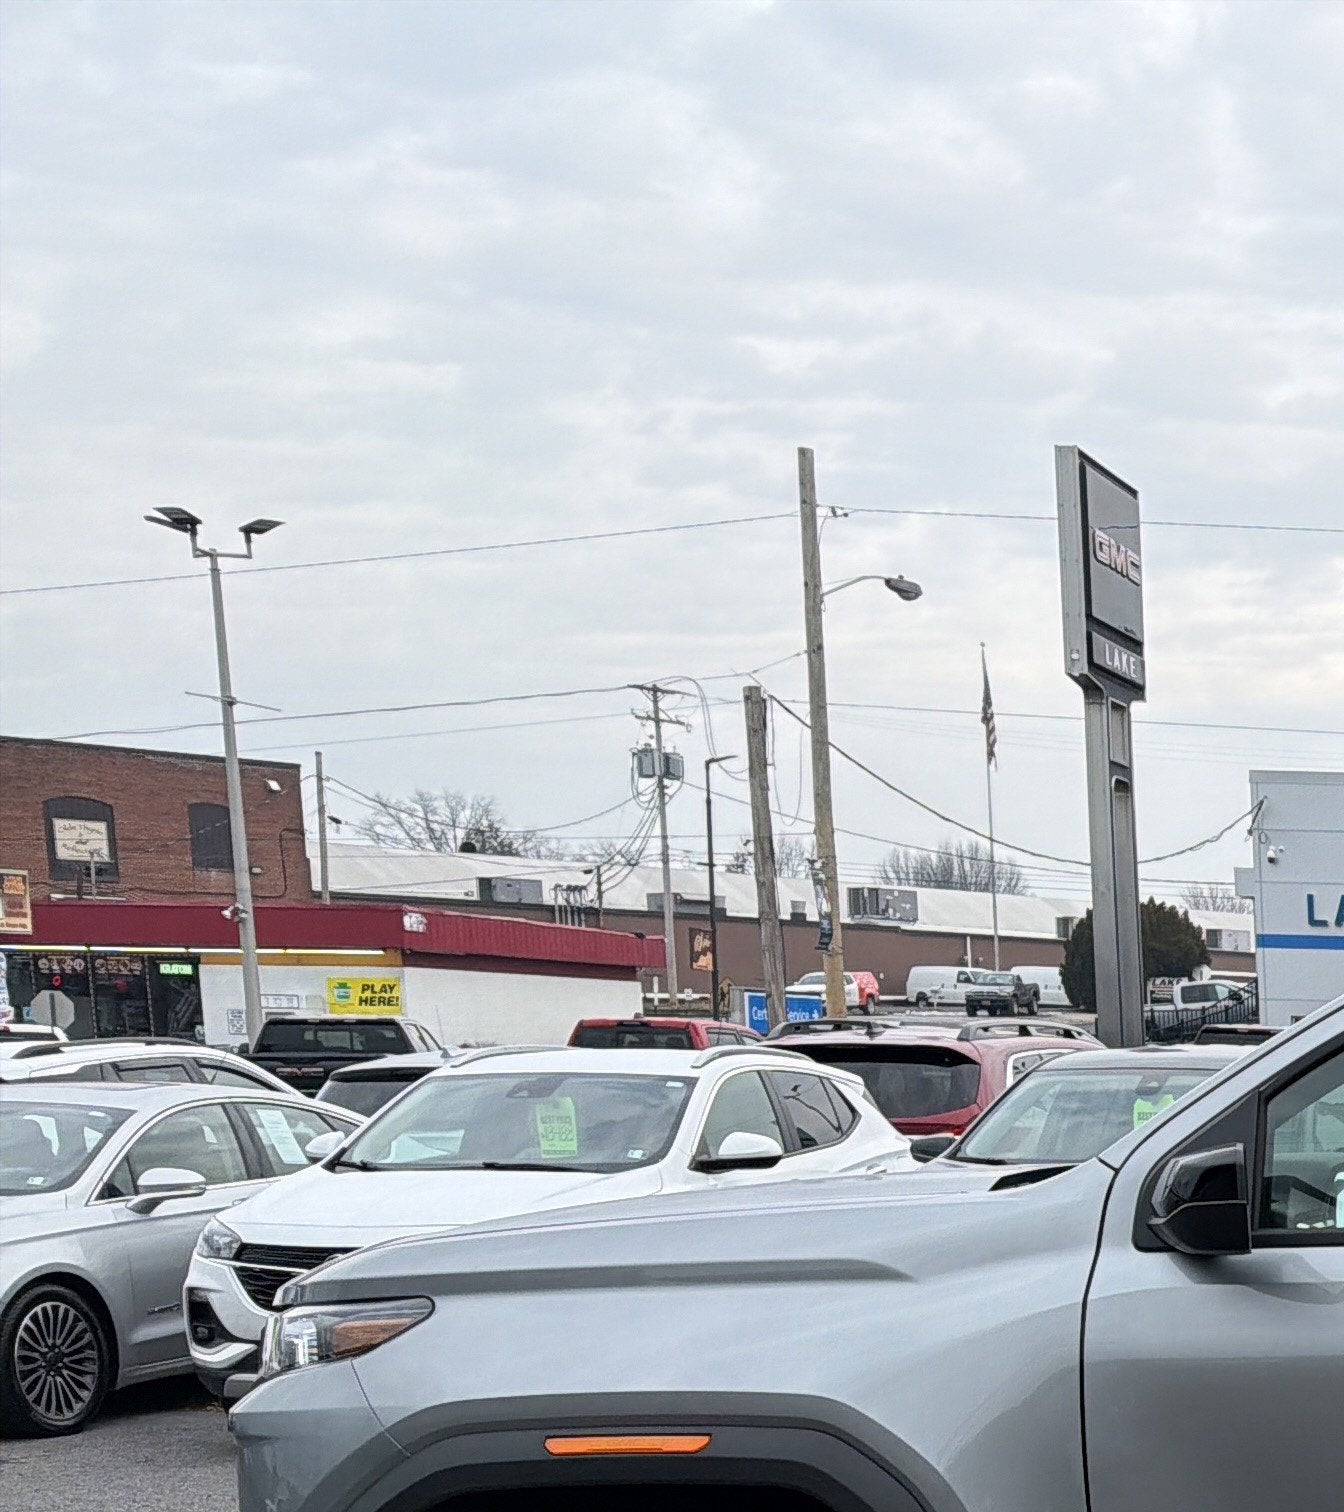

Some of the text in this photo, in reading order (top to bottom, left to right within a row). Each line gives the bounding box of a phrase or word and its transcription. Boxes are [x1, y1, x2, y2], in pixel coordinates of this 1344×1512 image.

[1093, 530, 1142, 586] GMC
[1104, 643, 1138, 678] LAKE
[360, 983, 397, 995] PLAY
[358, 995, 400, 1007] HERE!
